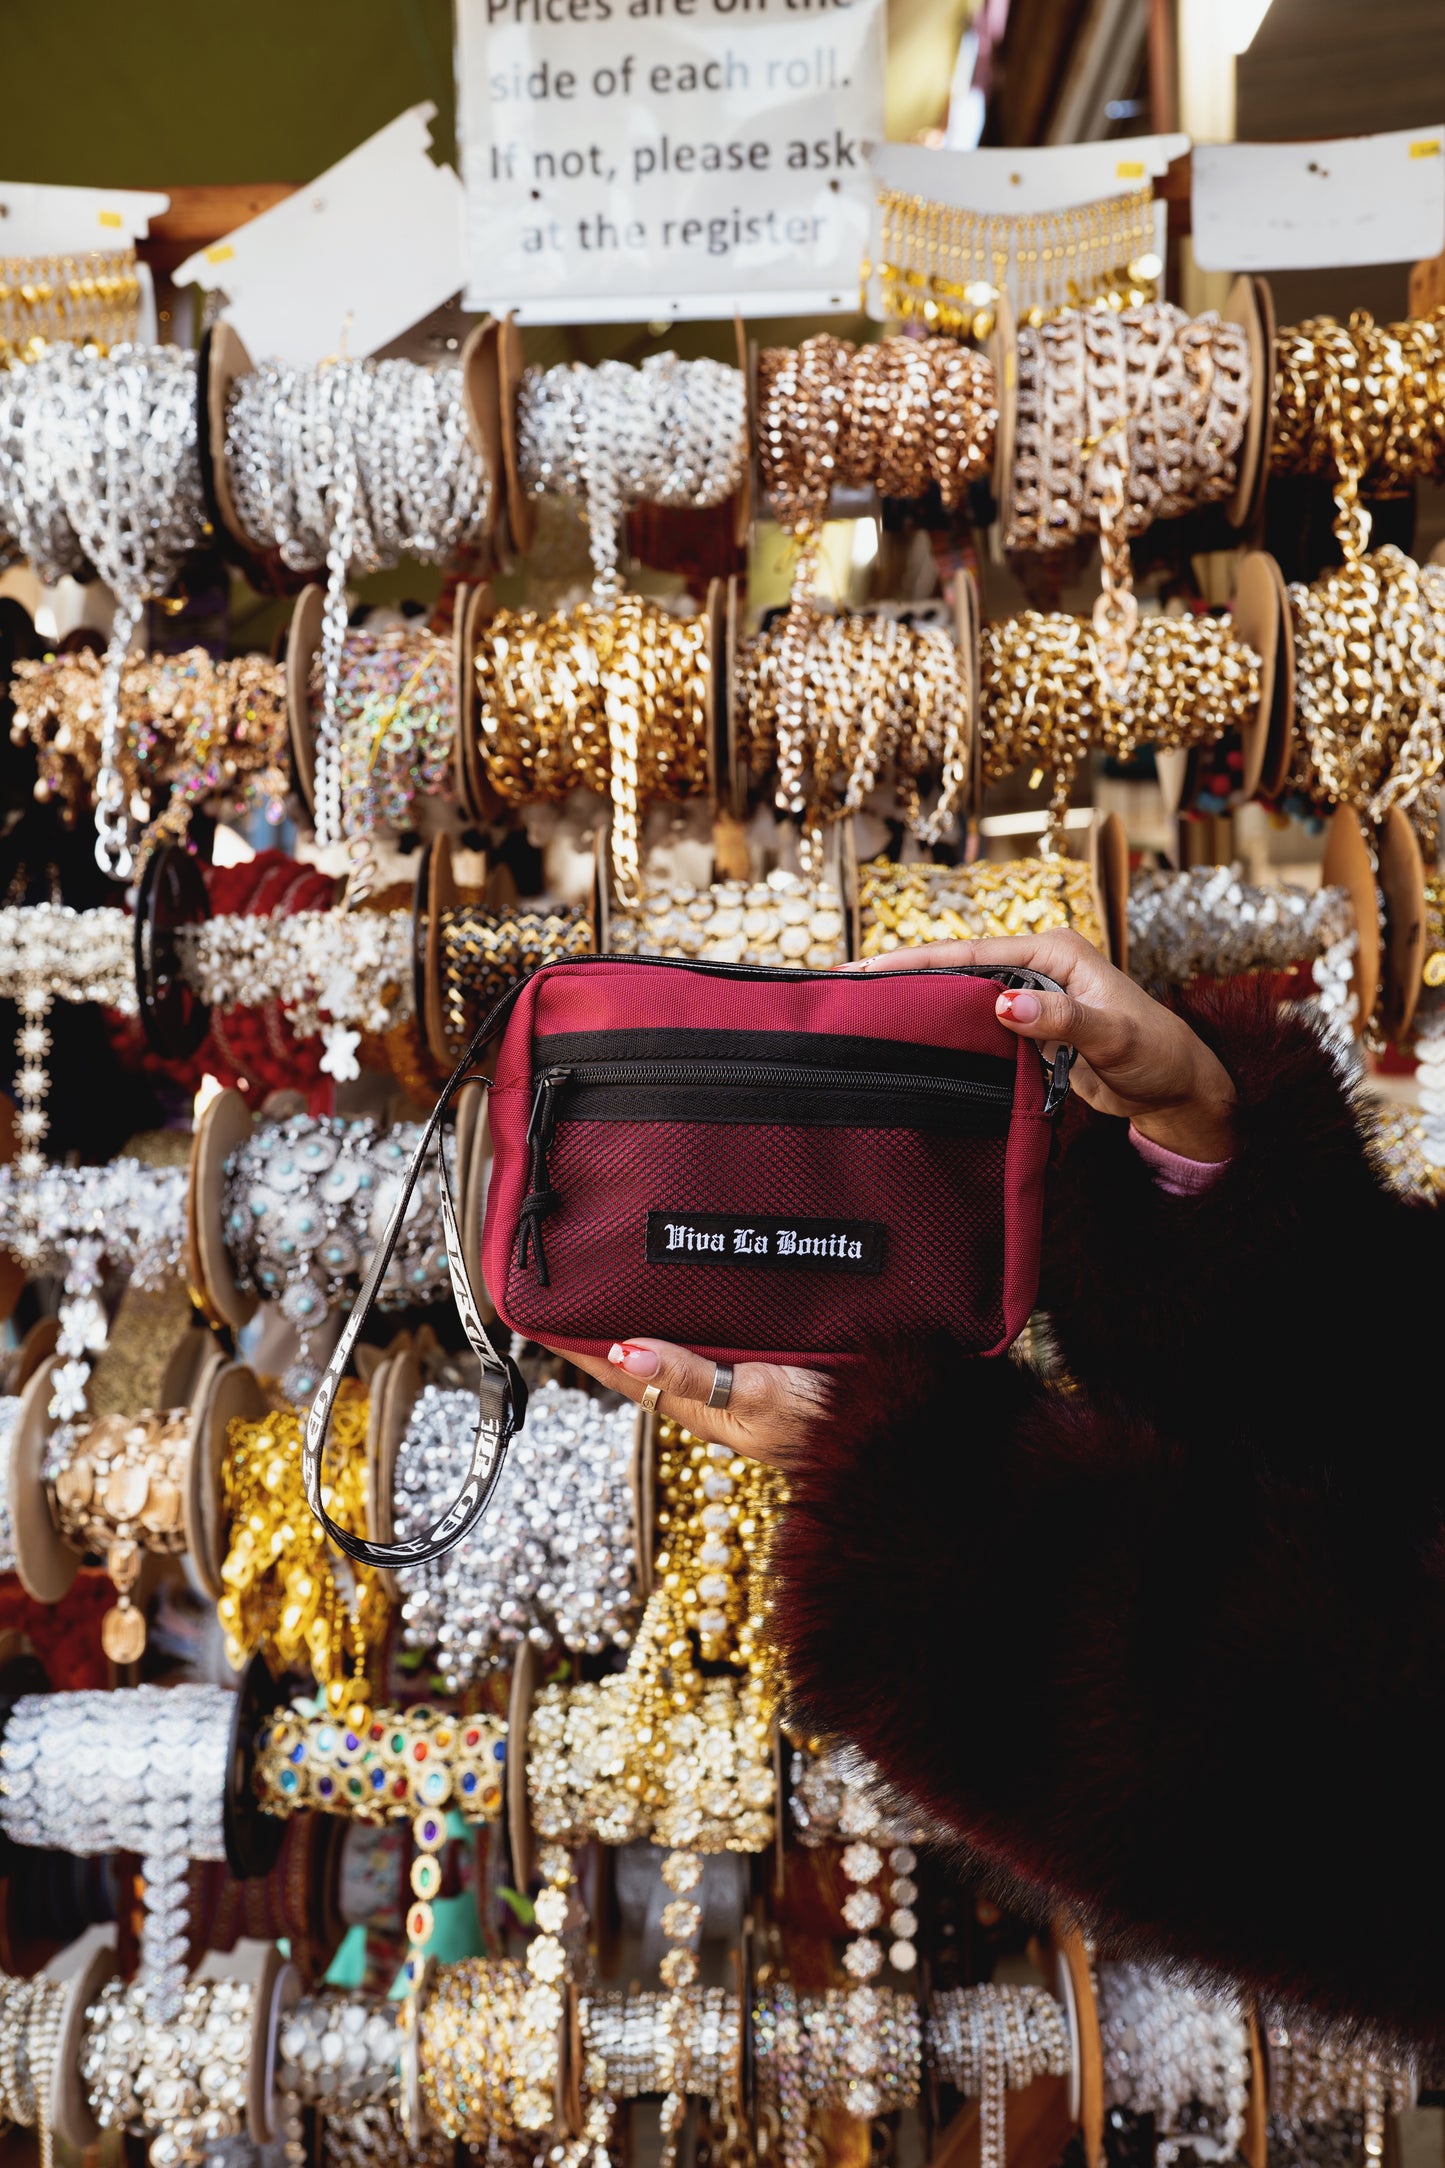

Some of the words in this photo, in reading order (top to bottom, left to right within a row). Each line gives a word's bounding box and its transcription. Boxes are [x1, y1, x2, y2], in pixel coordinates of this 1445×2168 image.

[487, 0, 612, 24] Prices
[489, 60, 576, 101] side
[592, 54, 635, 97] of
[649, 51, 750, 93] each
[766, 46, 851, 90] roll.
[490, 144, 519, 181] If
[533, 145, 617, 184] not,
[634, 135, 770, 182] please
[786, 129, 857, 170] ask
[522, 224, 565, 253] at
[578, 213, 646, 251] the
[662, 207, 825, 254] register
[664, 1223, 725, 1252] Viva
[733, 1229, 769, 1254] La
[776, 1230, 863, 1259] Bonita
